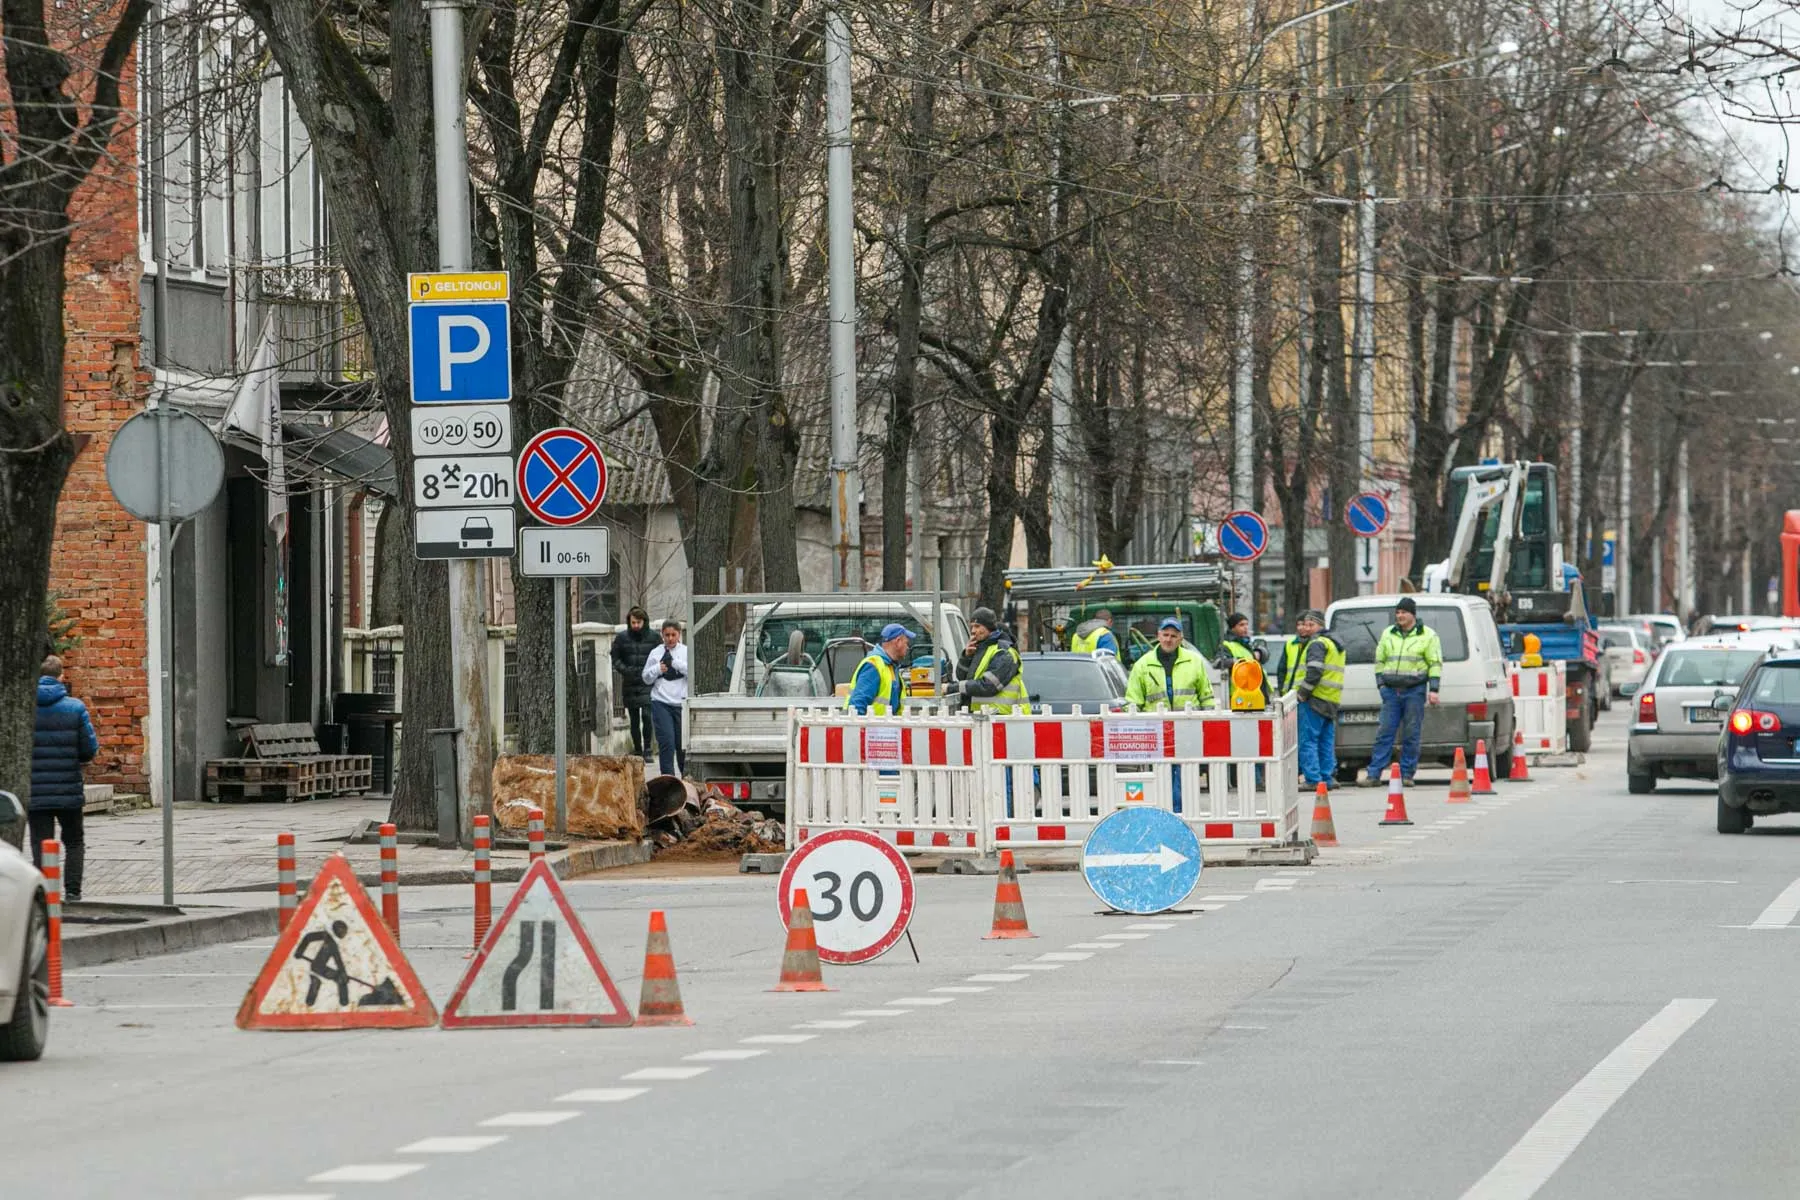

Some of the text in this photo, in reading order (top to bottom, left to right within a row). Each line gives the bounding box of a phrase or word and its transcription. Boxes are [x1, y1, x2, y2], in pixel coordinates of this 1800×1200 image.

[434, 280, 502, 293] GELTONOJI
[438, 315, 491, 392] P
[423, 421, 496, 439] 10 20 50
[557, 546, 591, 563] 00-6h
[811, 870, 884, 922] 30
